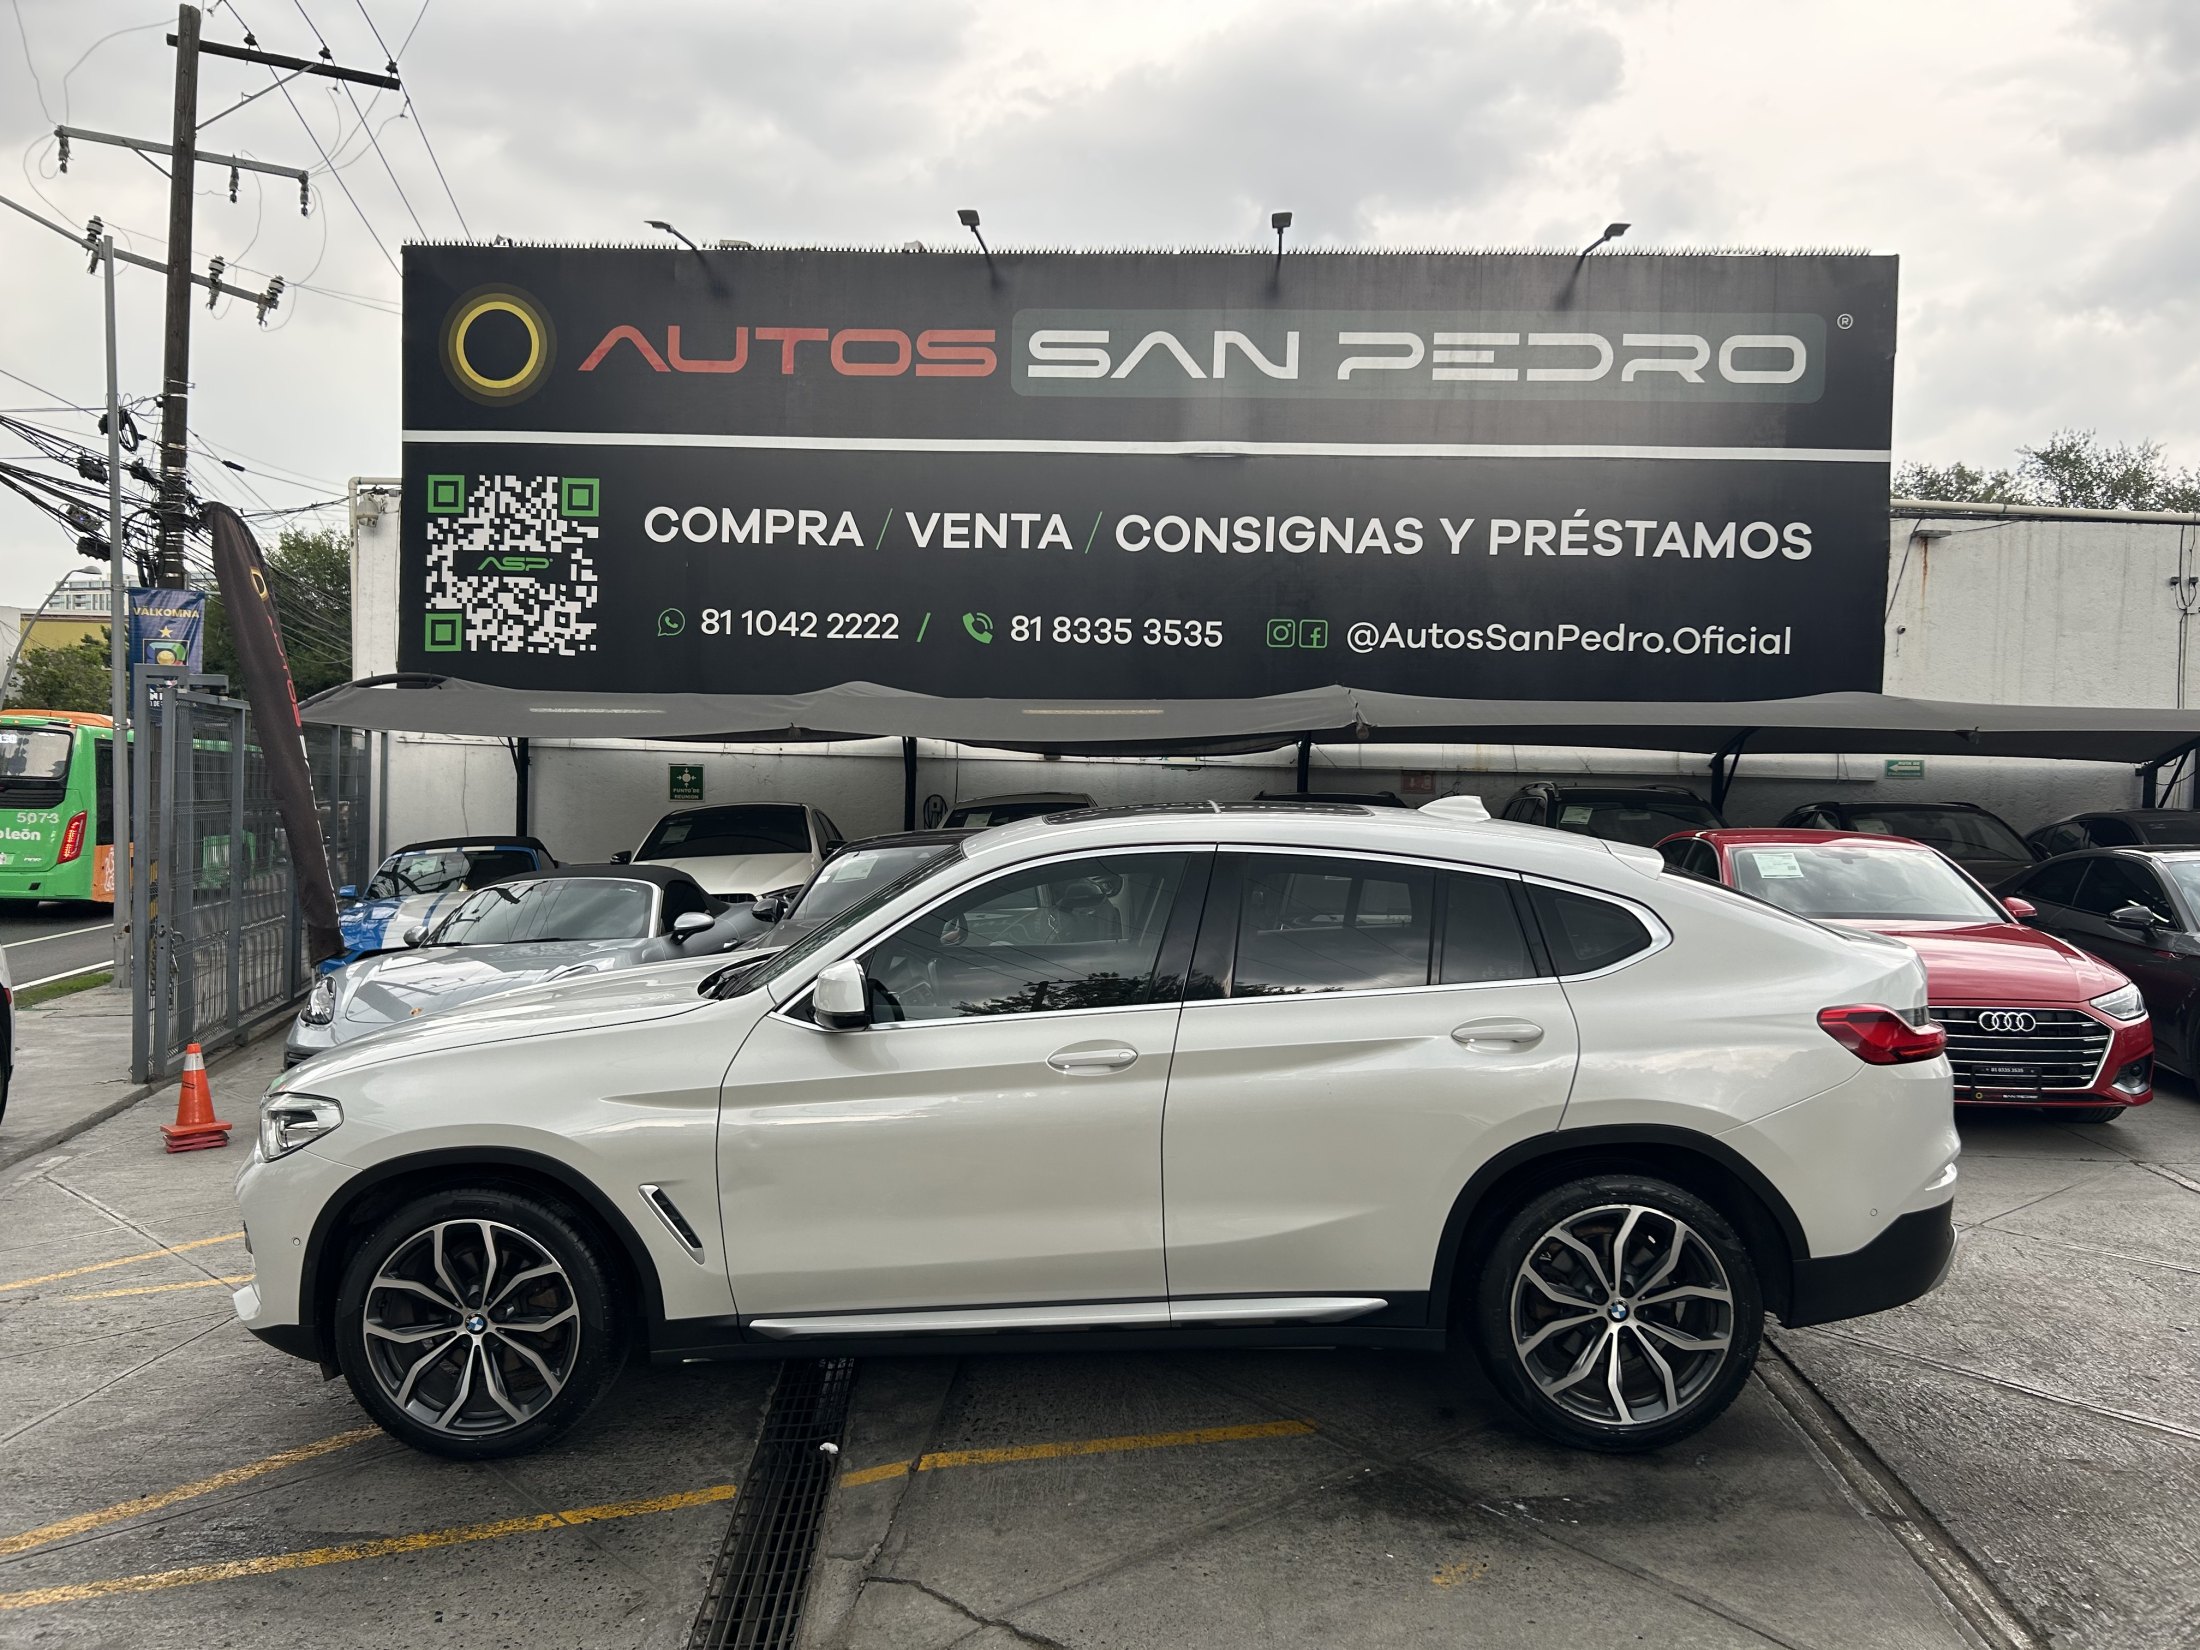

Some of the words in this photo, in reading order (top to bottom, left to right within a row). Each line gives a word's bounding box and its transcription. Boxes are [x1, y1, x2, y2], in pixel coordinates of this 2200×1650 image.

[579, 325, 997, 377] AUTOS
[1027, 329, 1299, 380] SAN
[1337, 331, 1807, 384] PEDRO
[644, 506, 865, 548] COMPRA
[905, 511, 1074, 551] VENTA
[1115, 514, 1424, 555] CONSIGNAS
[1439, 517, 1476, 555] Y
[1489, 508, 1812, 560] PRÉSTAMOS
[701, 608, 732, 635] 81
[741, 609, 818, 638] 1042
[826, 612, 899, 640] 2222
[1010, 615, 1042, 642] 81
[1052, 616, 1133, 645] 8335
[1142, 618, 1223, 648] 3535
[1346, 621, 1791, 656] @AutosSanPedro.Oficial
